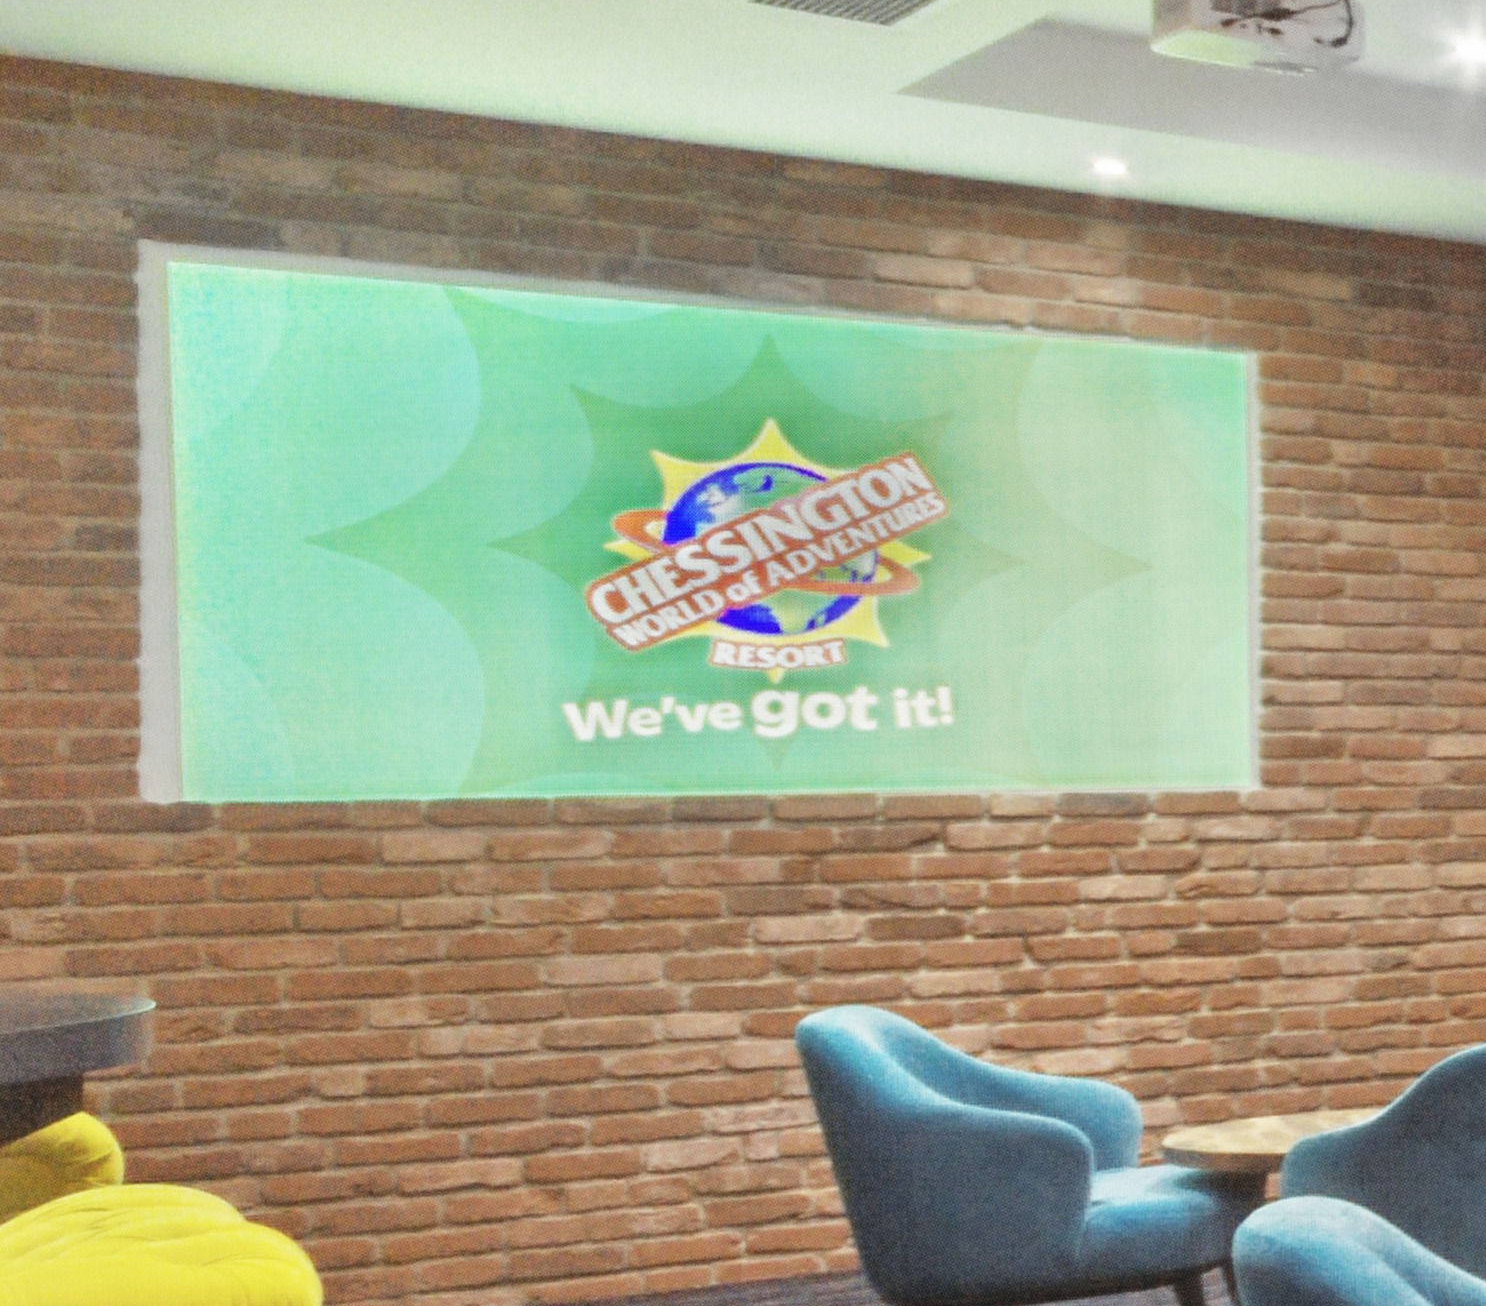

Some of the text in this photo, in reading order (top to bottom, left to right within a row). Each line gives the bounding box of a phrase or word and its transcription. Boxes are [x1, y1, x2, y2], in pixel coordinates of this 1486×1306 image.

[591, 457, 935, 625] CHESSINGTON
[613, 495, 946, 648] WORLD of ADVENTURES
[713, 642, 844, 668] RESORT
[562, 687, 955, 742] We've got it!
